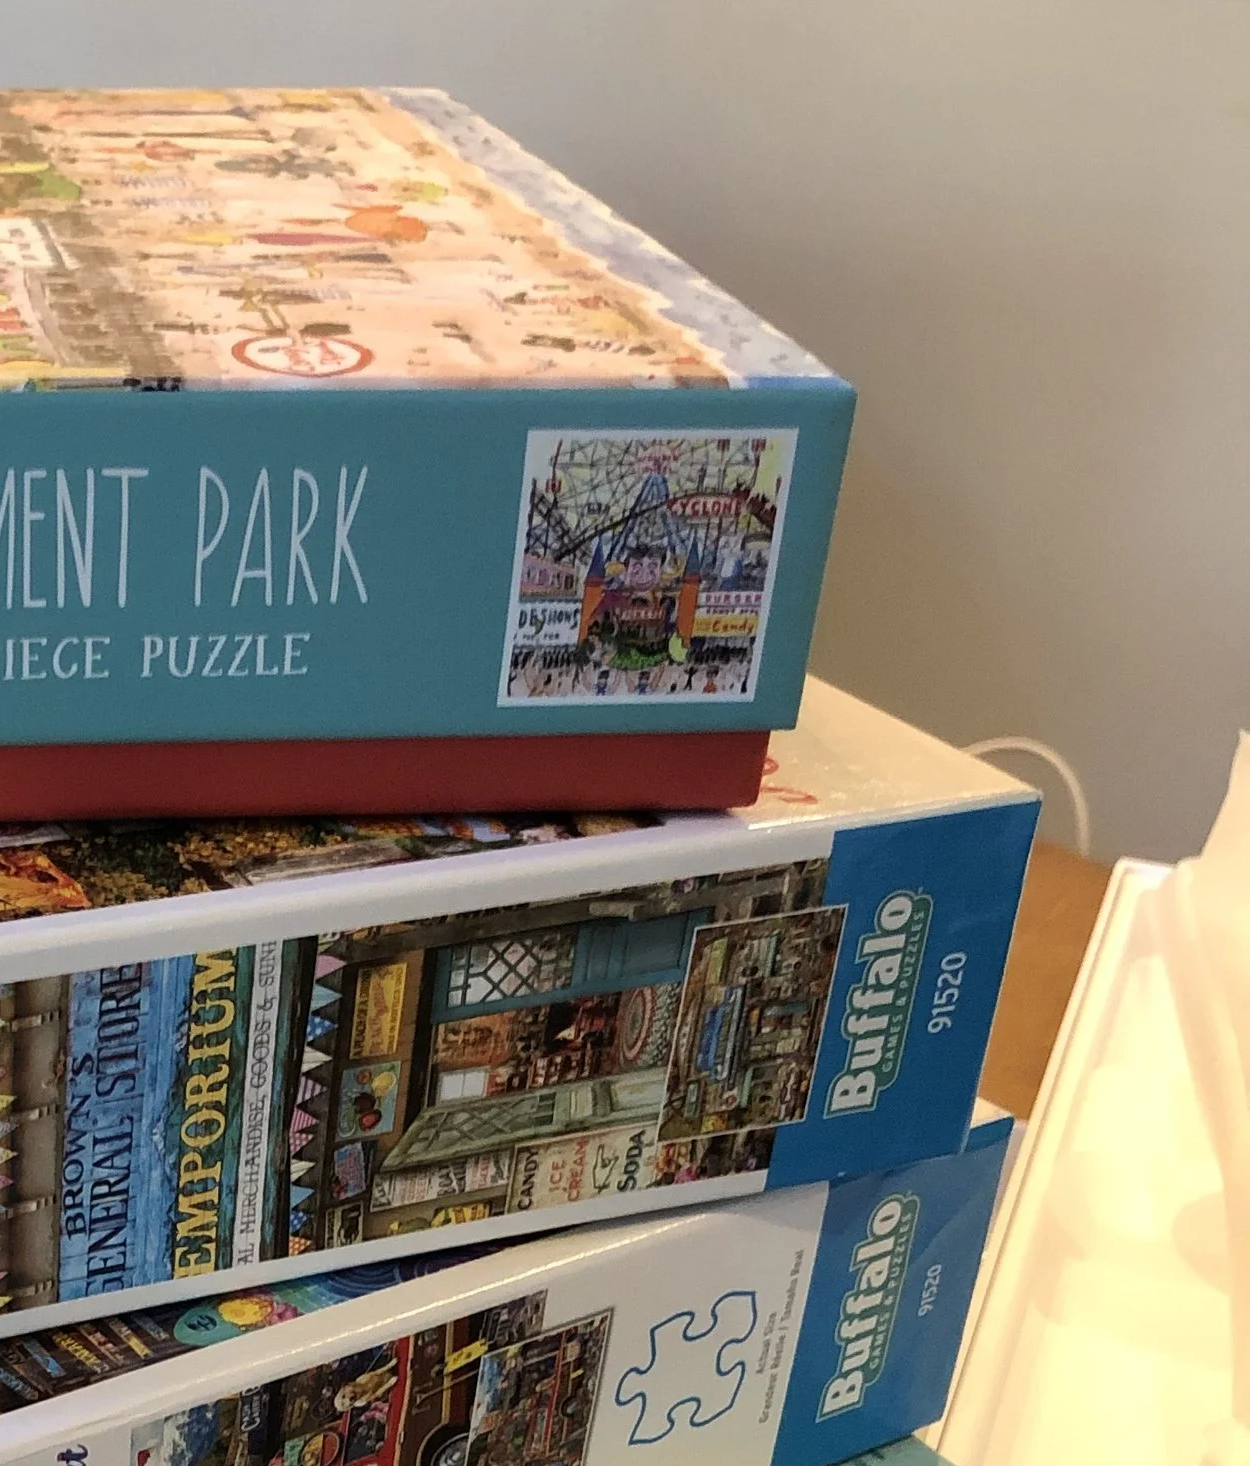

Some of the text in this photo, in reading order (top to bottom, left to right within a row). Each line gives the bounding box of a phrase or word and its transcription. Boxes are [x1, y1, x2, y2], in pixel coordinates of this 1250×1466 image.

[195, 463, 370, 610] PARK
[139, 631, 312, 678] PUZZLE
[830, 894, 914, 1113] Buffalo
[882, 910, 925, 1073] GAMES & PUZZLES
[927, 951, 967, 1034] 91520
[250, 1019, 271, 1090] GOODS
[65, 1052, 93, 1241] BROWN'S
[86, 961, 148, 1297] GENERAL STORE
[174, 947, 237, 1280] EMPORIUM
[517, 1150, 539, 1210] CANDY
[549, 1160, 567, 1192] ICE
[567, 1140, 589, 1201] CREAM
[617, 1130, 646, 1192] SODA
[821, 1200, 902, 1415] Buffalo
[918, 1264, 942, 1317] 91520
